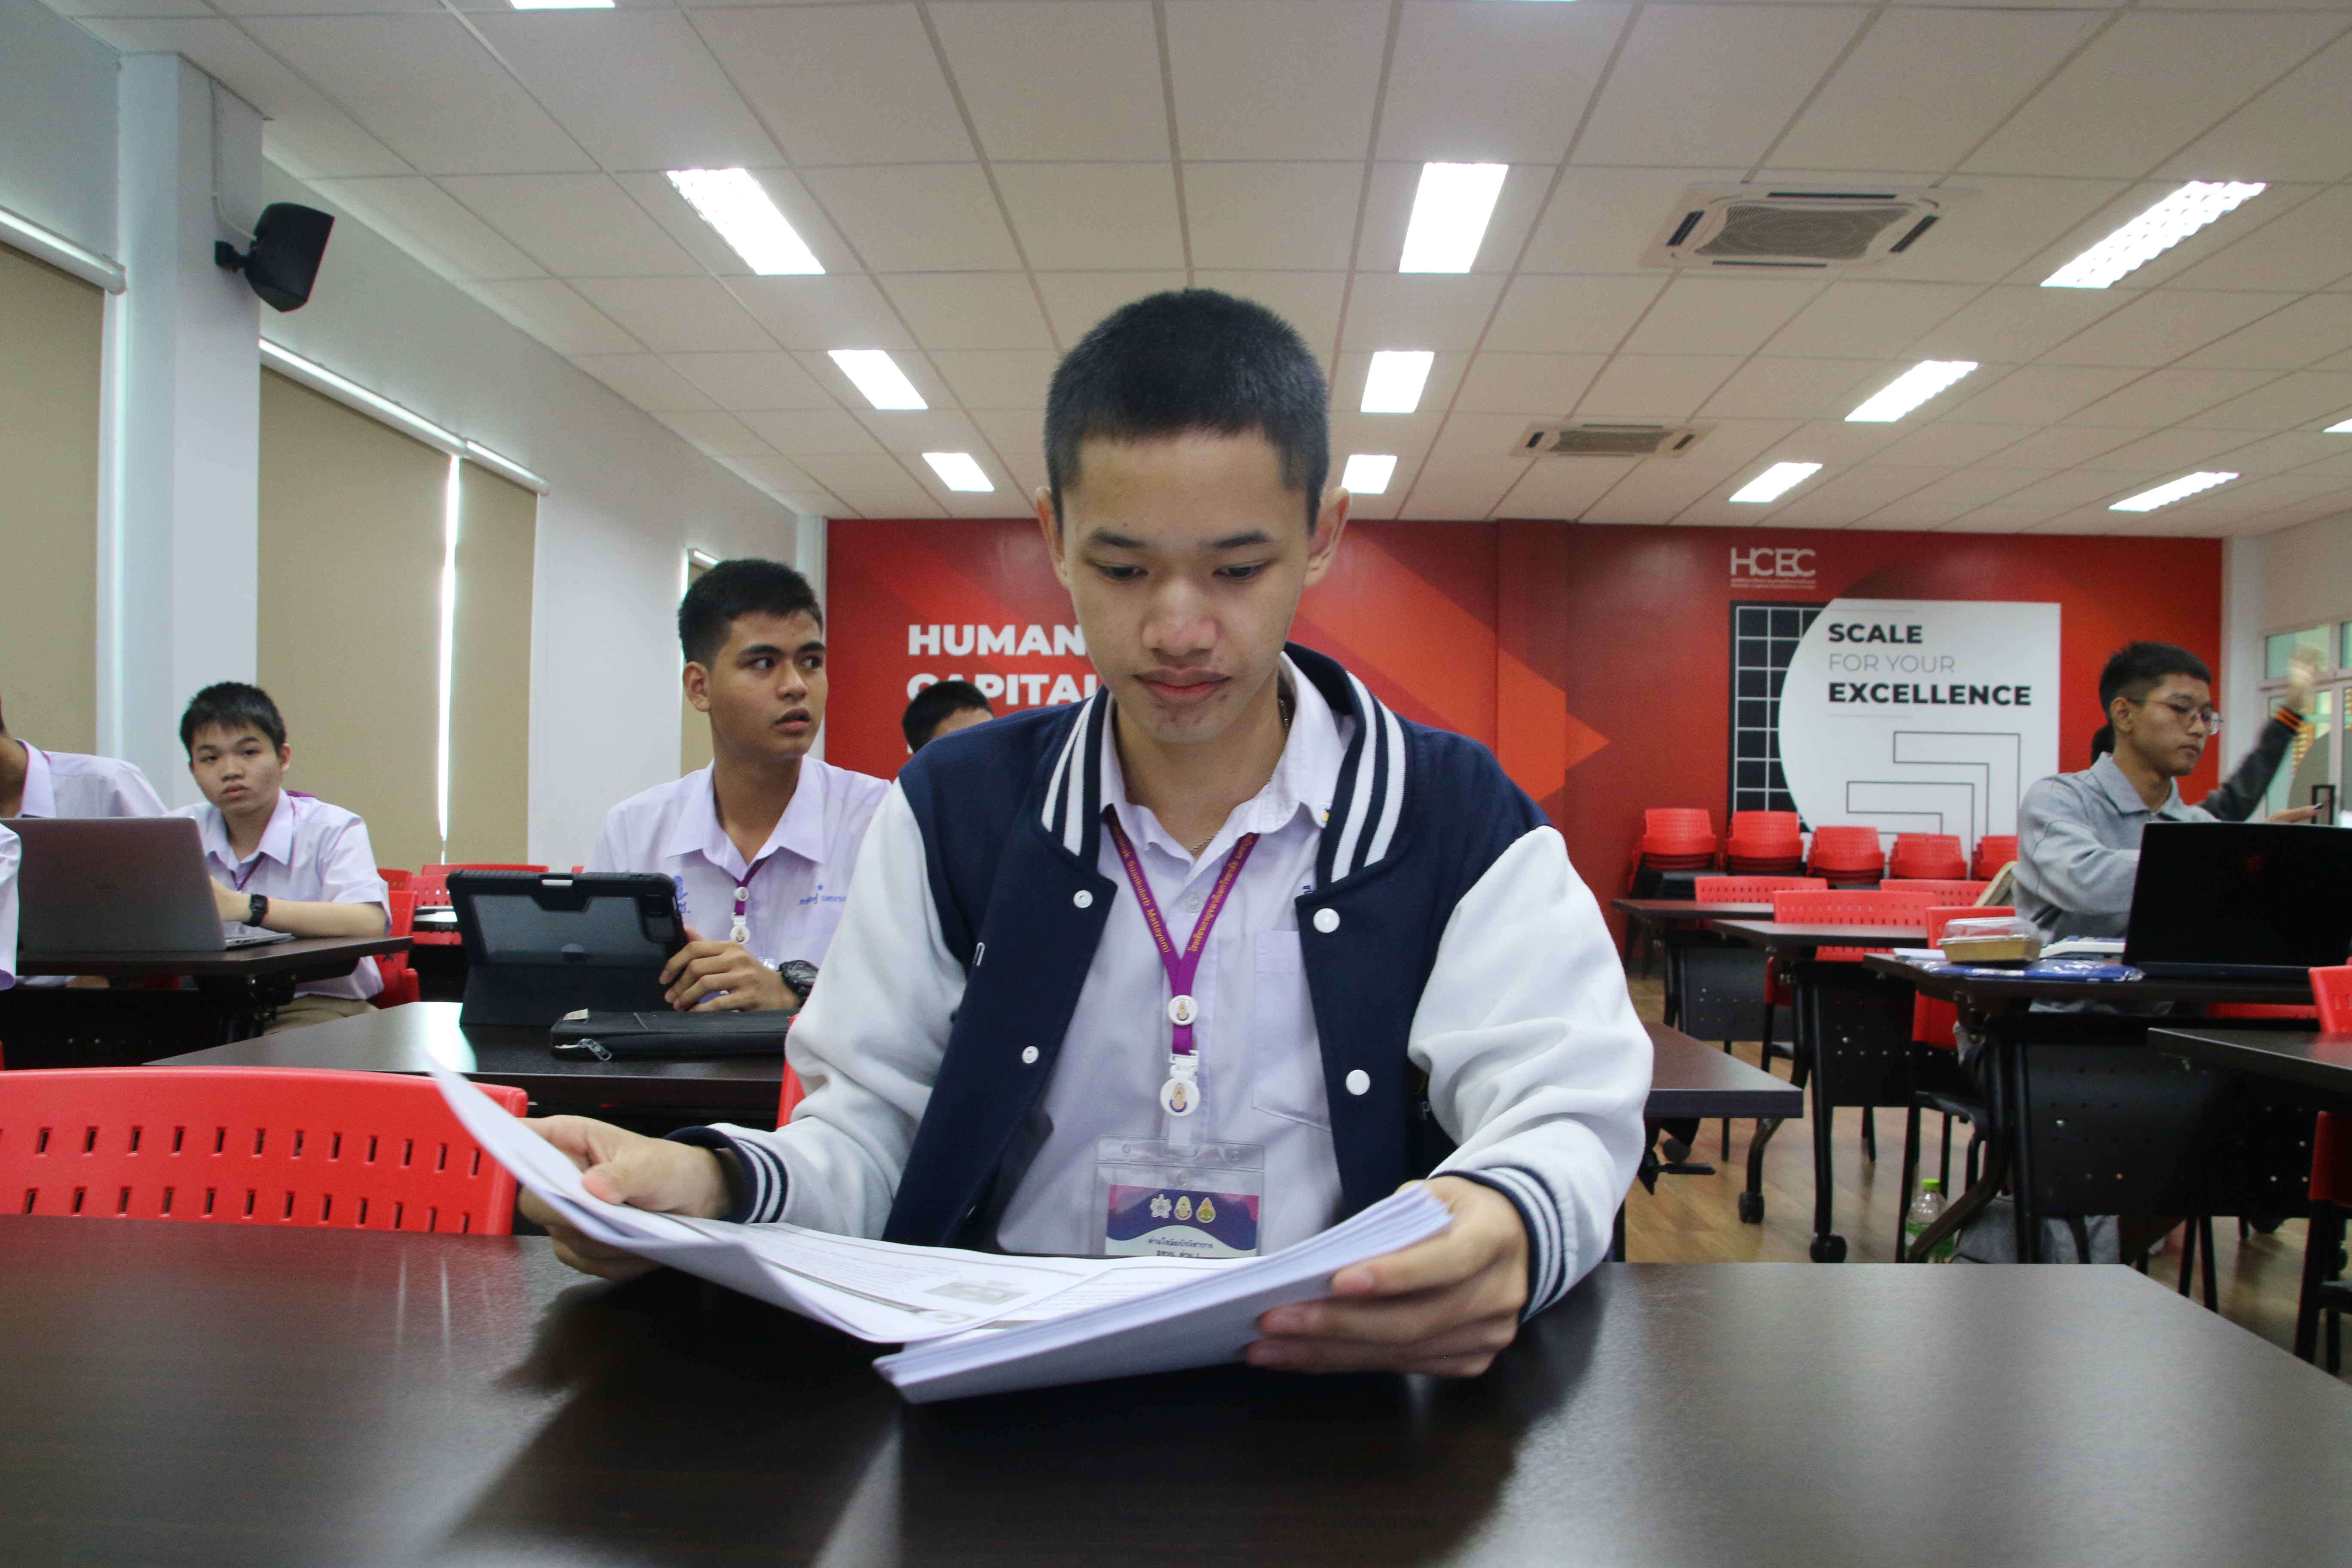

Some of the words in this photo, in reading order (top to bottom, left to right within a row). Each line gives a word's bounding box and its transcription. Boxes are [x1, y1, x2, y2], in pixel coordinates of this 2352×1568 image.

[1730, 547, 1816, 577] HCEC
[908, 625, 1087, 655] HUMAN
[1828, 623, 1923, 643] SCALE
[1829, 653, 1878, 672] FOR
[1886, 654, 1955, 673] YOUR
[906, 673, 1099, 705] CPITA
[1828, 683, 2031, 706] EXCELLENCE
